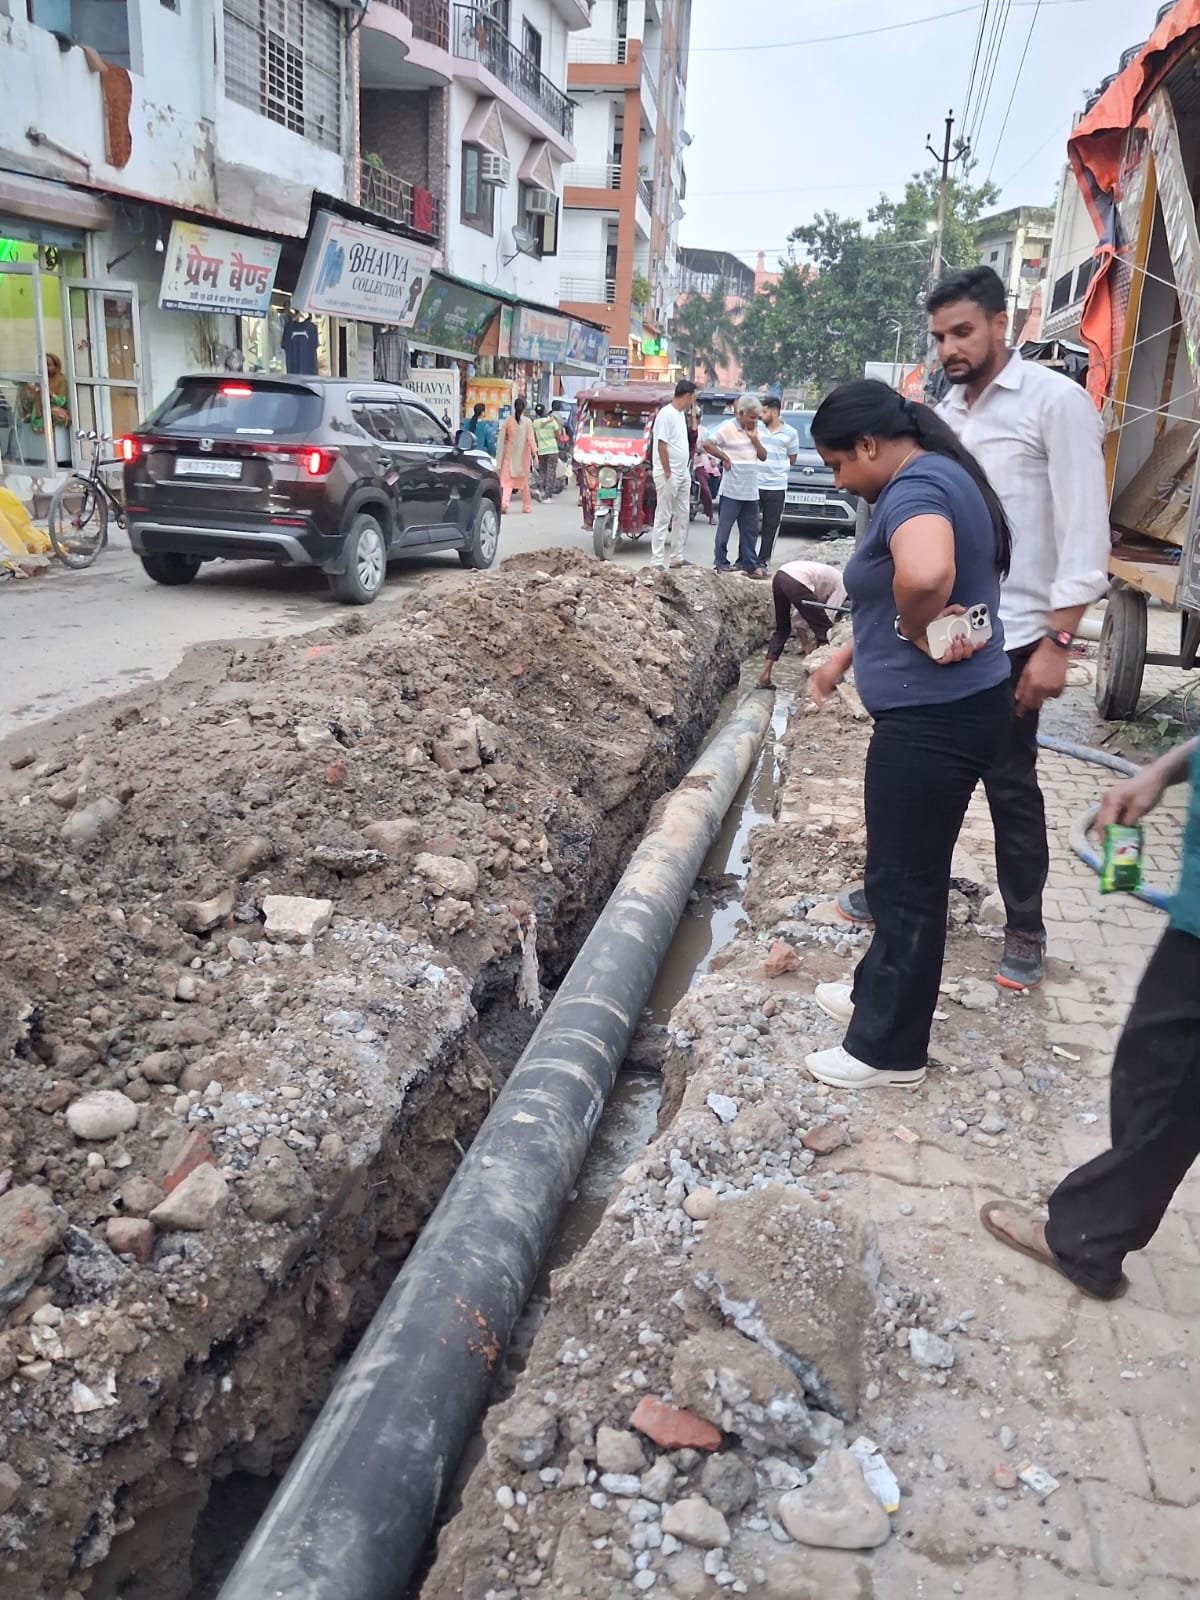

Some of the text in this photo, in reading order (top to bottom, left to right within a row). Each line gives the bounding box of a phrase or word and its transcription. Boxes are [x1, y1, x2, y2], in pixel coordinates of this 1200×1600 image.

[184, 244, 272, 294] प्रेम बैण्ड
[349, 242, 409, 282] BHAVYA
[352, 276, 405, 298] COLLECTION
[405, 380, 451, 395] BHAVYA
